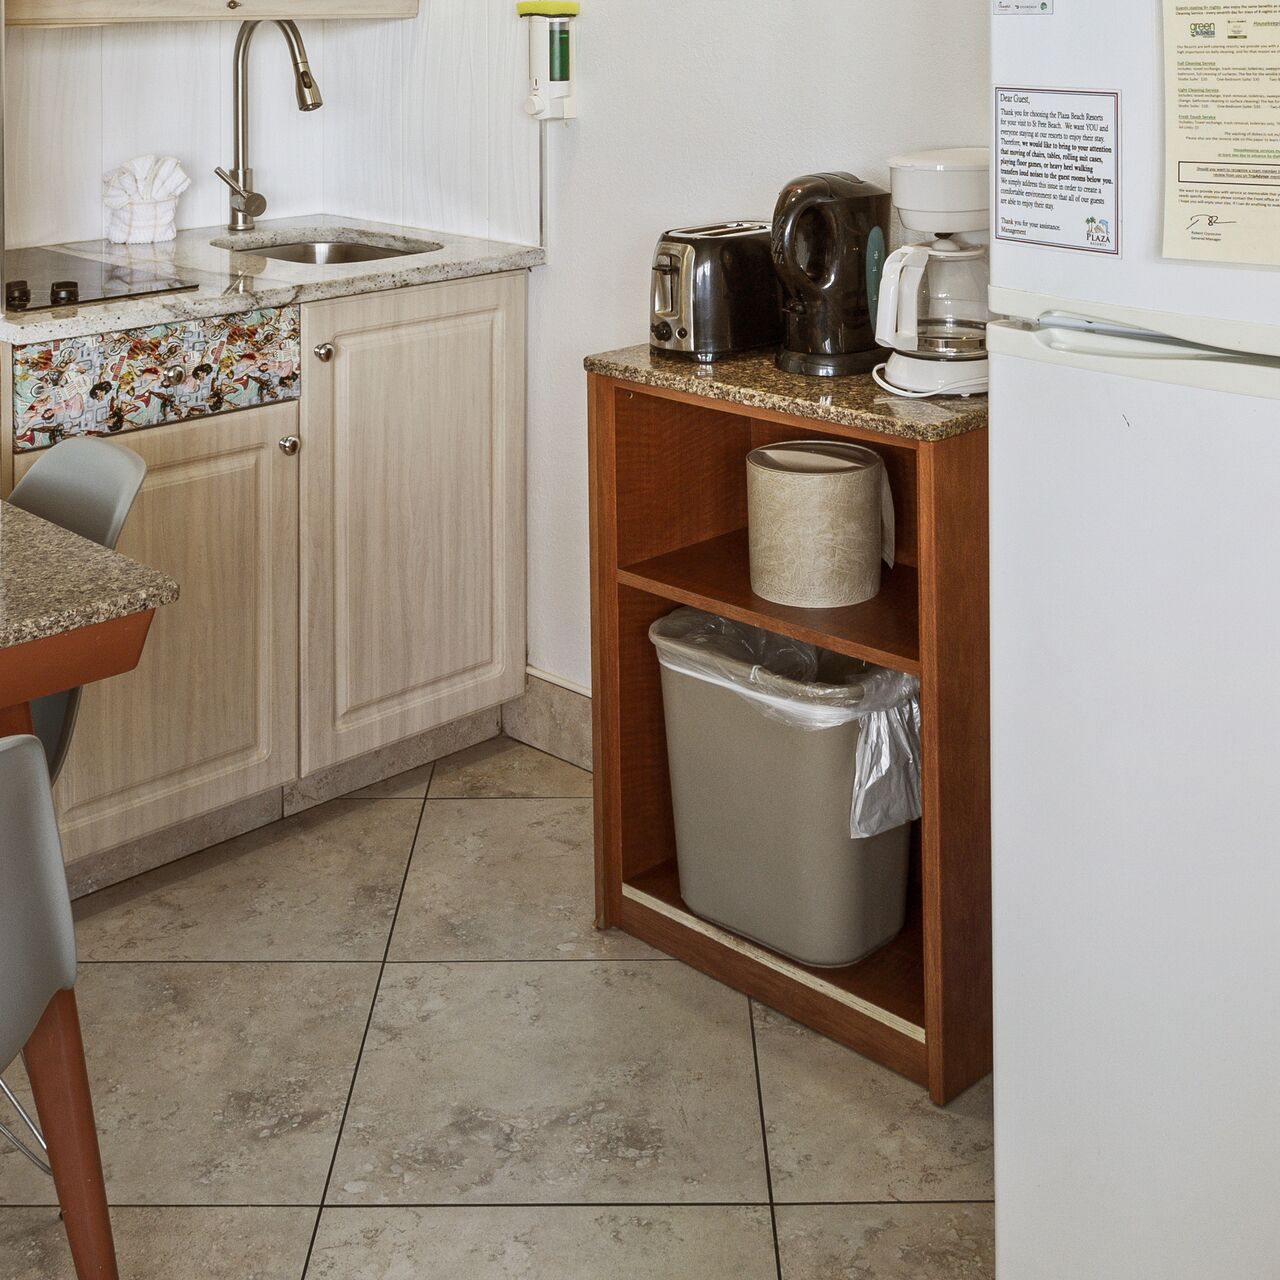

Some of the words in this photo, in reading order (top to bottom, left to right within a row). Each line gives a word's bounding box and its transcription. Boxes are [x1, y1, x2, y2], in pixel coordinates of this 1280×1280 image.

[1190, 22, 1215, 33] green
[1000, 94, 1013, 103] Dear
[1013, 95, 1030, 104] Guest,
[1030, 110, 1048, 118] choosing
[1019, 130, 1034, 138] staying
[1059, 142, 1070, 150] bring
[1090, 144, 1112, 153] attention
[1010, 149, 1025, 157] moving
[1032, 150, 1046, 159] chairs,
[1047, 152, 1061, 160] tables,
[1063, 153, 1078, 162] rolling
[1050, 162, 1062, 170] heavy
[1074, 165, 1093, 173] walking
[1087, 175, 1101, 183] below
[1065, 183, 1076, 191] order
[1001, 188, 1024, 196] comfortable
[1025, 190, 1051, 199] environment
[1022, 200, 1033, 208] enjoy
[1086, 233, 1110, 243] PLAZA
